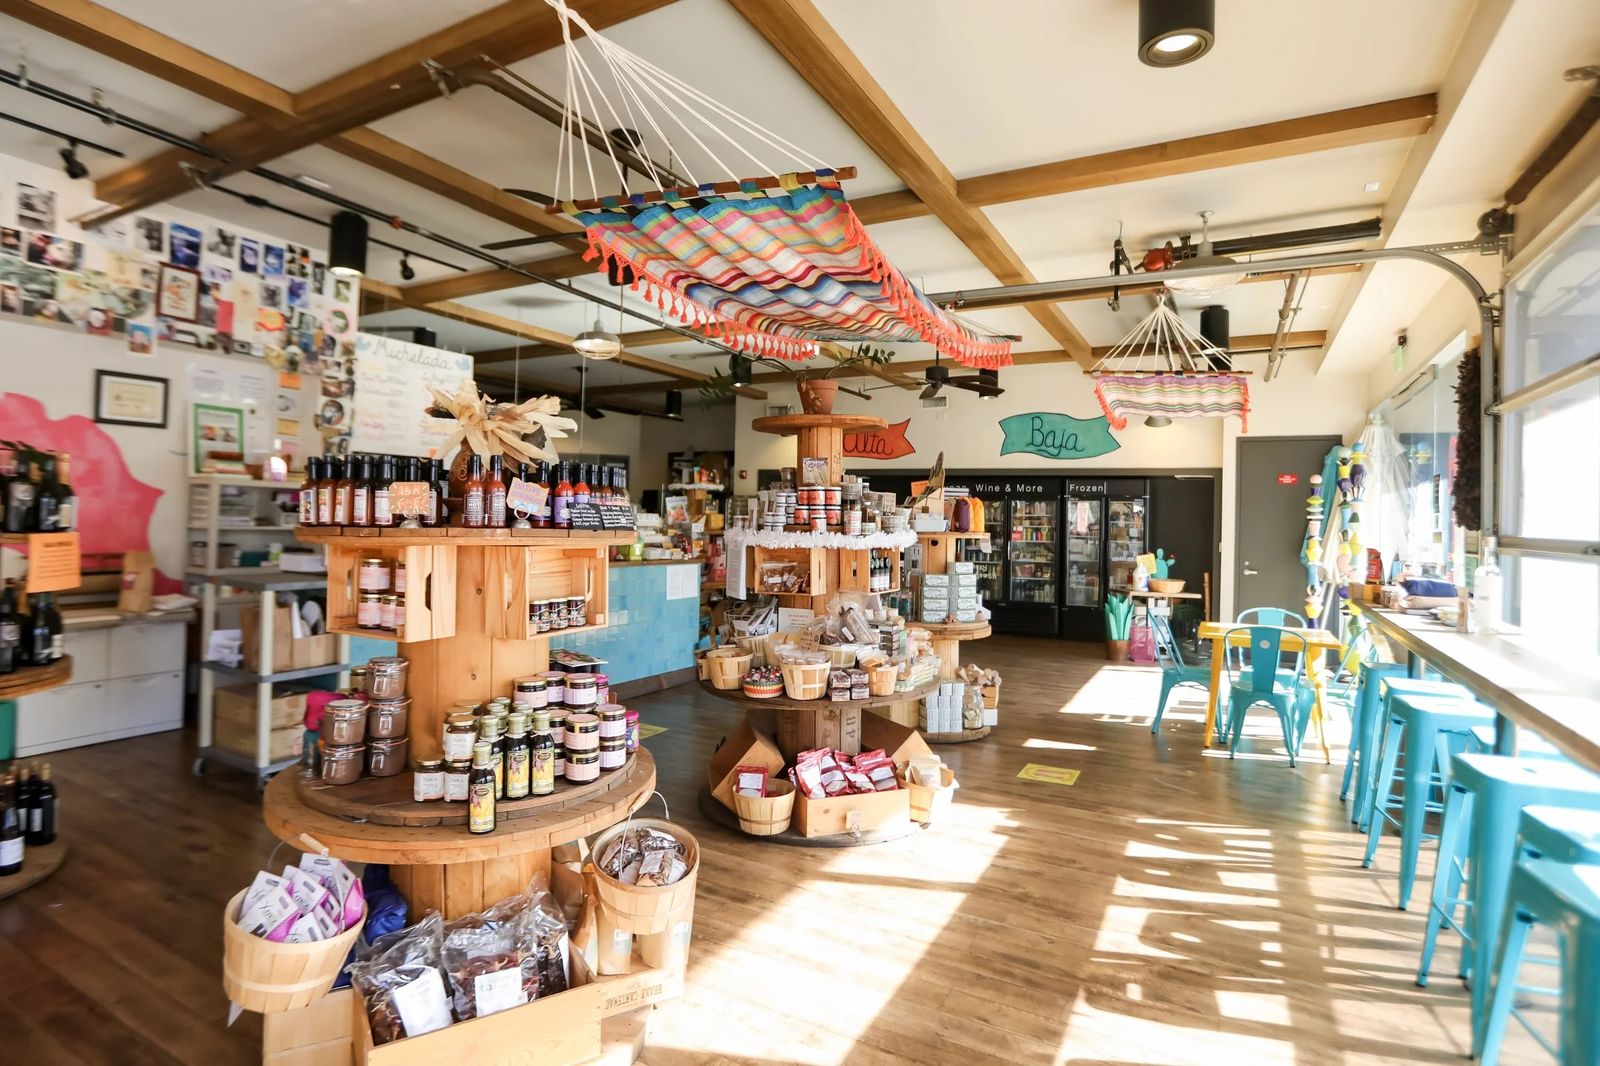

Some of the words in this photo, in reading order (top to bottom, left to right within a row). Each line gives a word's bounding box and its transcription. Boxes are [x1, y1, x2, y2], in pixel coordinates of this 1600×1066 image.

[1025, 416, 1085, 457] Baja
[975, 483, 1000, 493] Wine
[1005, 484, 1012, 492] &
[1016, 483, 1043, 493] More
[1069, 483, 1104, 492] Frozen
